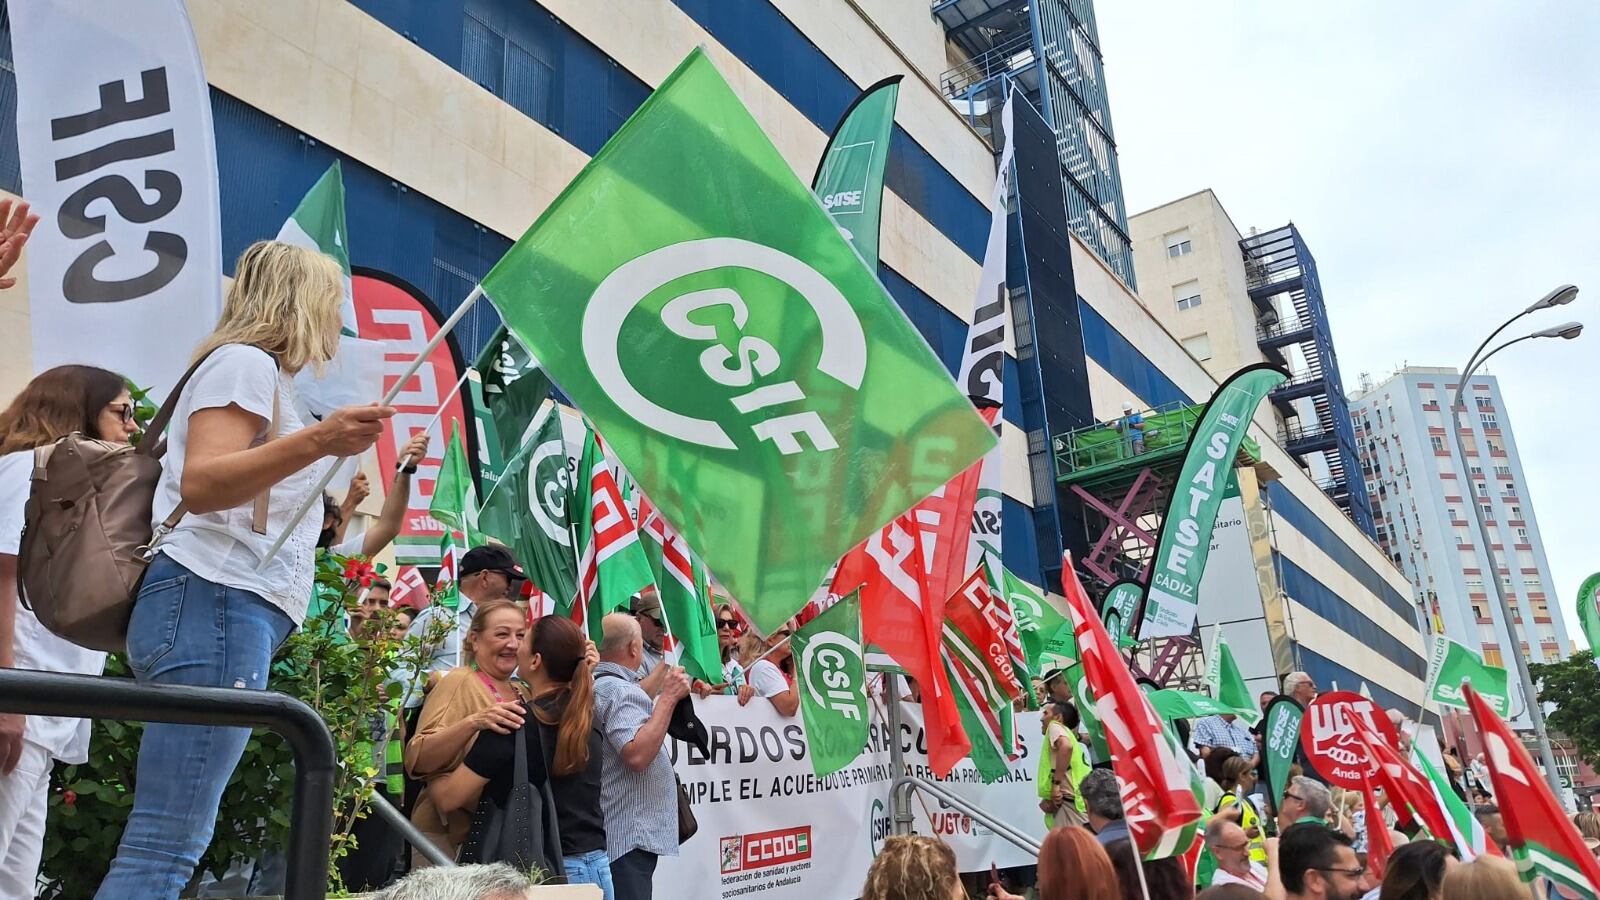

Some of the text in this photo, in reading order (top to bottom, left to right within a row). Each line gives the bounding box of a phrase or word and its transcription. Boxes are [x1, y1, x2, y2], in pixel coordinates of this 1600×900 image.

[823, 190, 862, 209] SATSE
[660, 288, 840, 455] CSIF
[1167, 431, 1230, 576] SATSE
[1212, 519, 1242, 531] sitario
[1155, 572, 1193, 598] CÁDIZ
[817, 648, 861, 721] CSIF
[1270, 704, 1290, 751] SATSE
[1280, 715, 1300, 759] Cádiz
[1310, 701, 1384, 742] UGT
[681, 779, 732, 806] MPLE
[740, 778, 763, 800] EL
[770, 770, 839, 798] ACUERDO
[839, 770, 852, 789] DE
[932, 812, 961, 835] UGT
[747, 835, 797, 862] CCOO
[754, 870, 762, 879] de
[763, 866, 785, 878] sanidad
[790, 862, 811, 872] sectores
[722, 875, 801, 899] sociosanitarios de Andalucía
